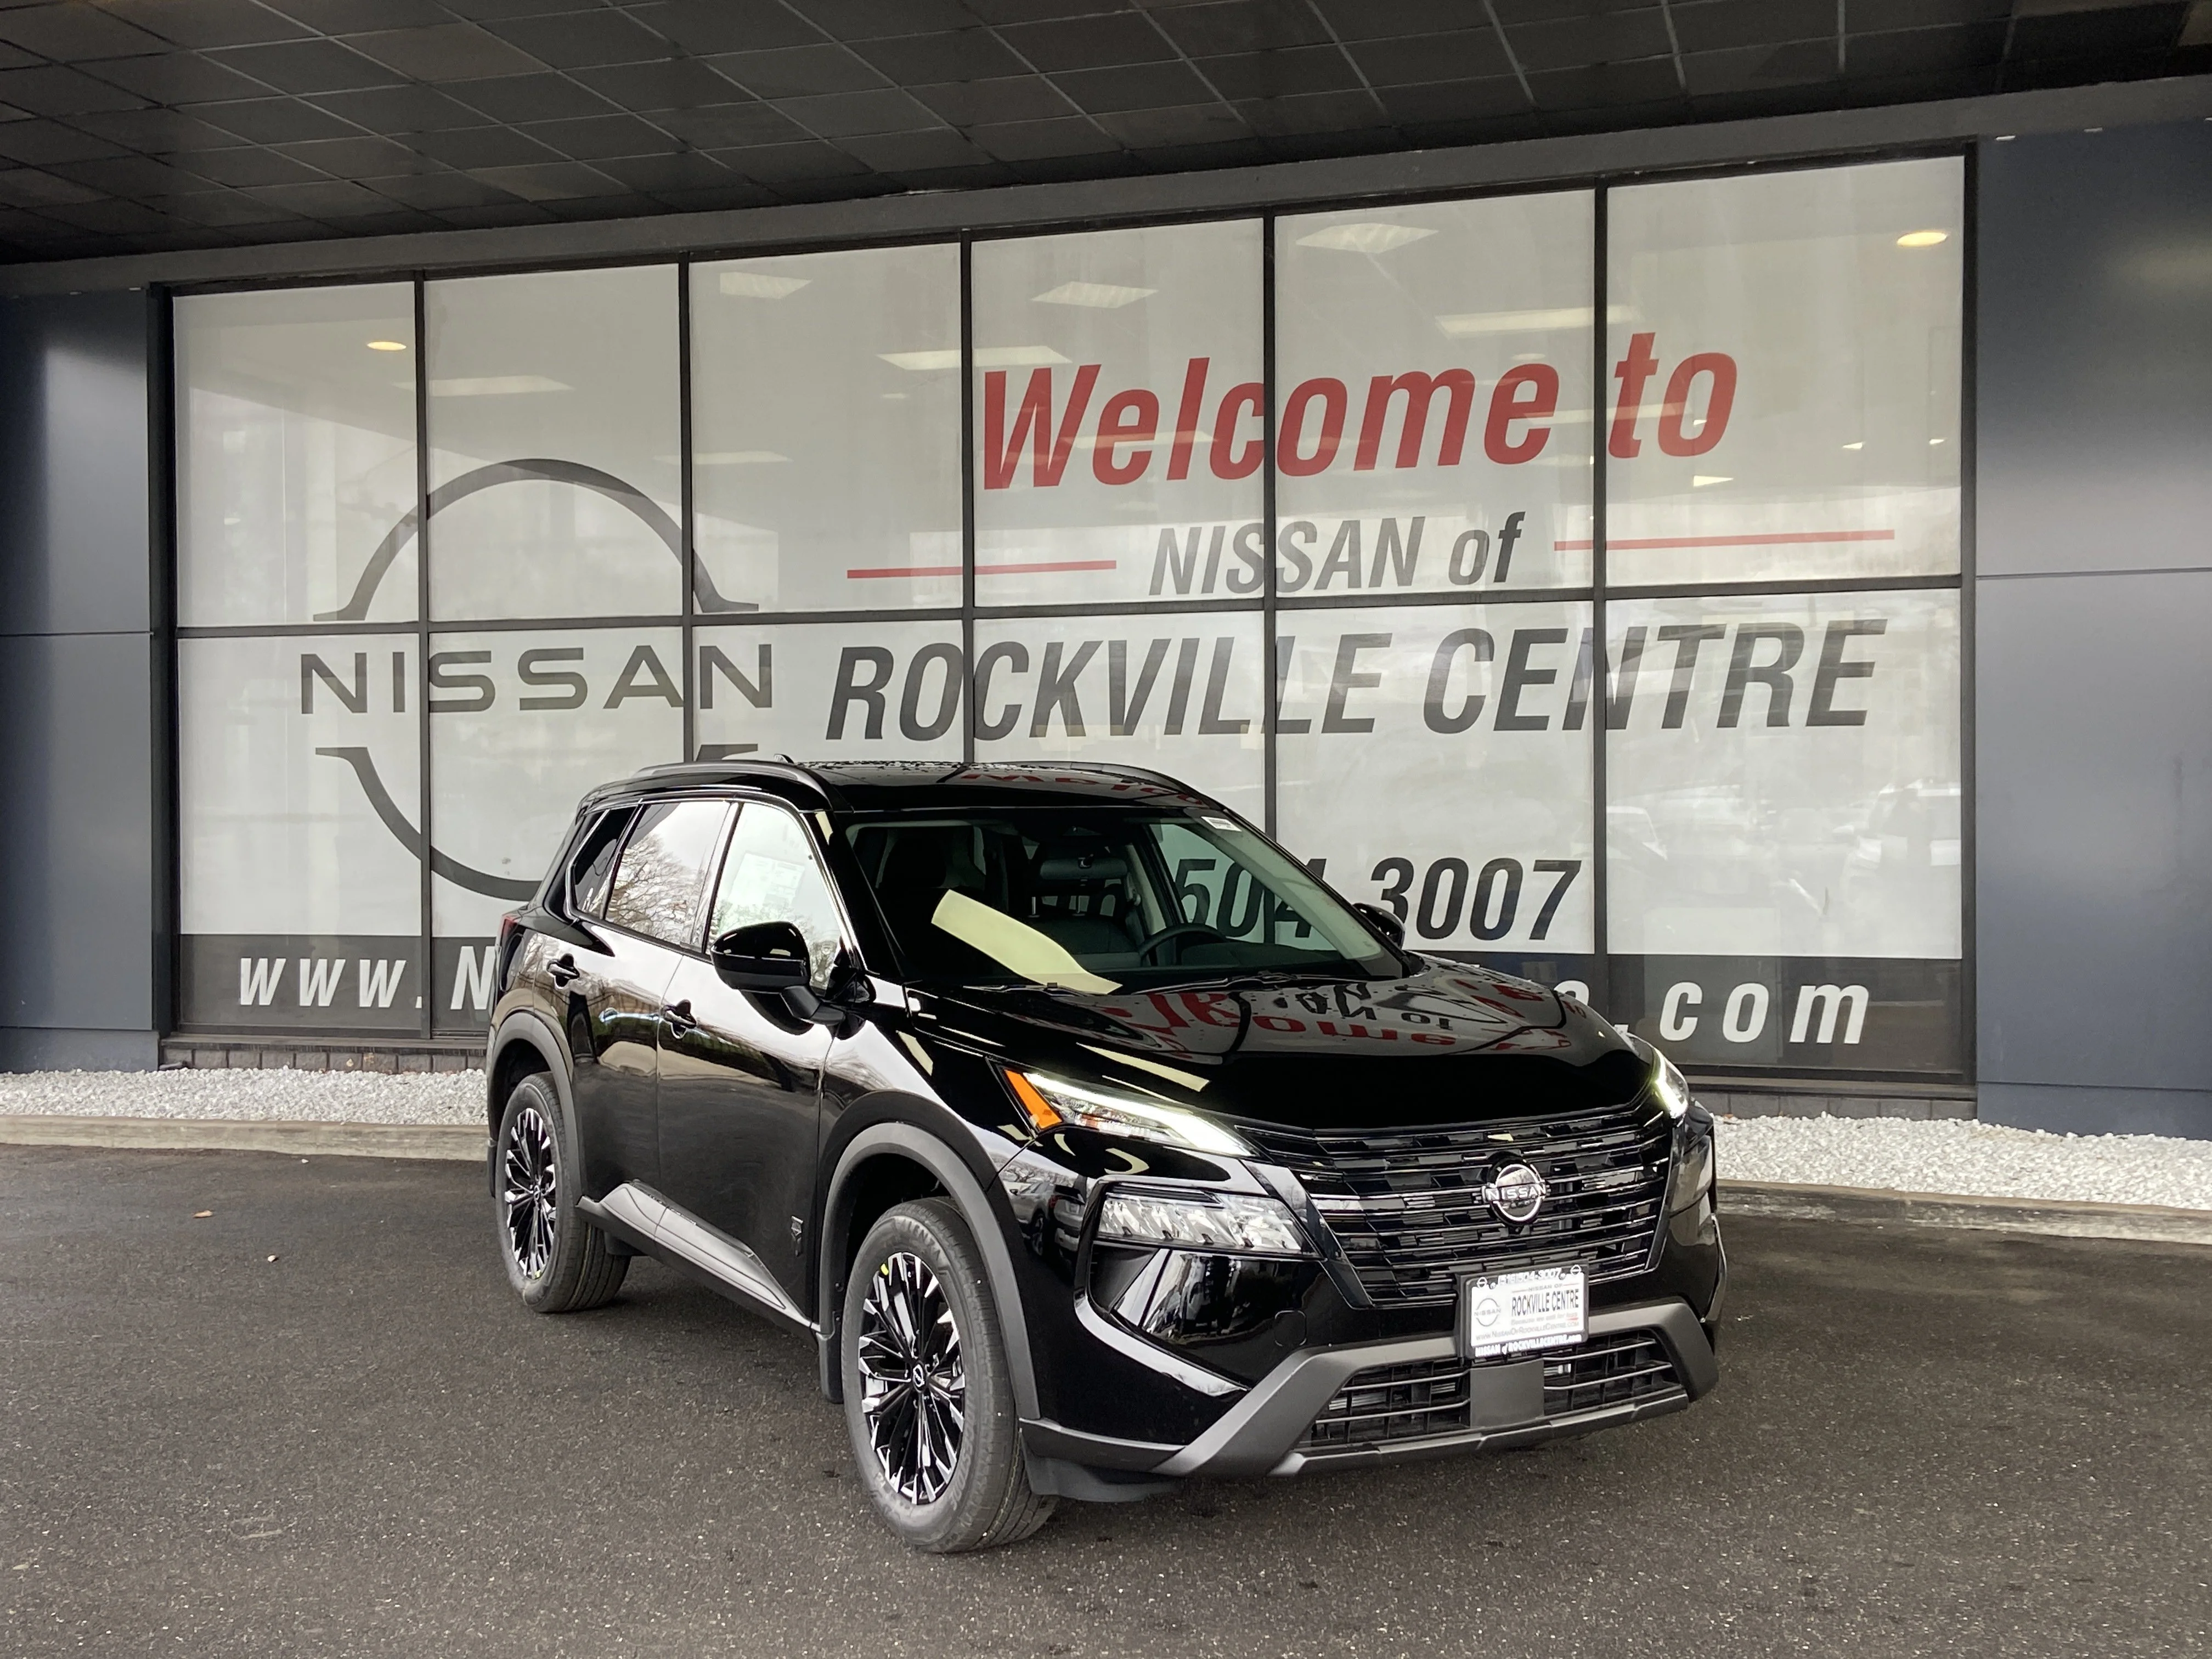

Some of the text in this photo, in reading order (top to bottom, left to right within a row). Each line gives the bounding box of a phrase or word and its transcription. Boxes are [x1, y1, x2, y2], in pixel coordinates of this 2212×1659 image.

[984, 332, 1737, 490] Welcome to
[1149, 511, 1525, 595] NISSAN of
[301, 644, 772, 714] NISSAN
[825, 619, 1888, 741] ROCKVILLE CENTRE
[1487, 1183, 1546, 1200] NISSAN
[1474, 1308, 1501, 1317] NISSAN
[1511, 1289, 1579, 1317] ROCKVILLE CENTRE
